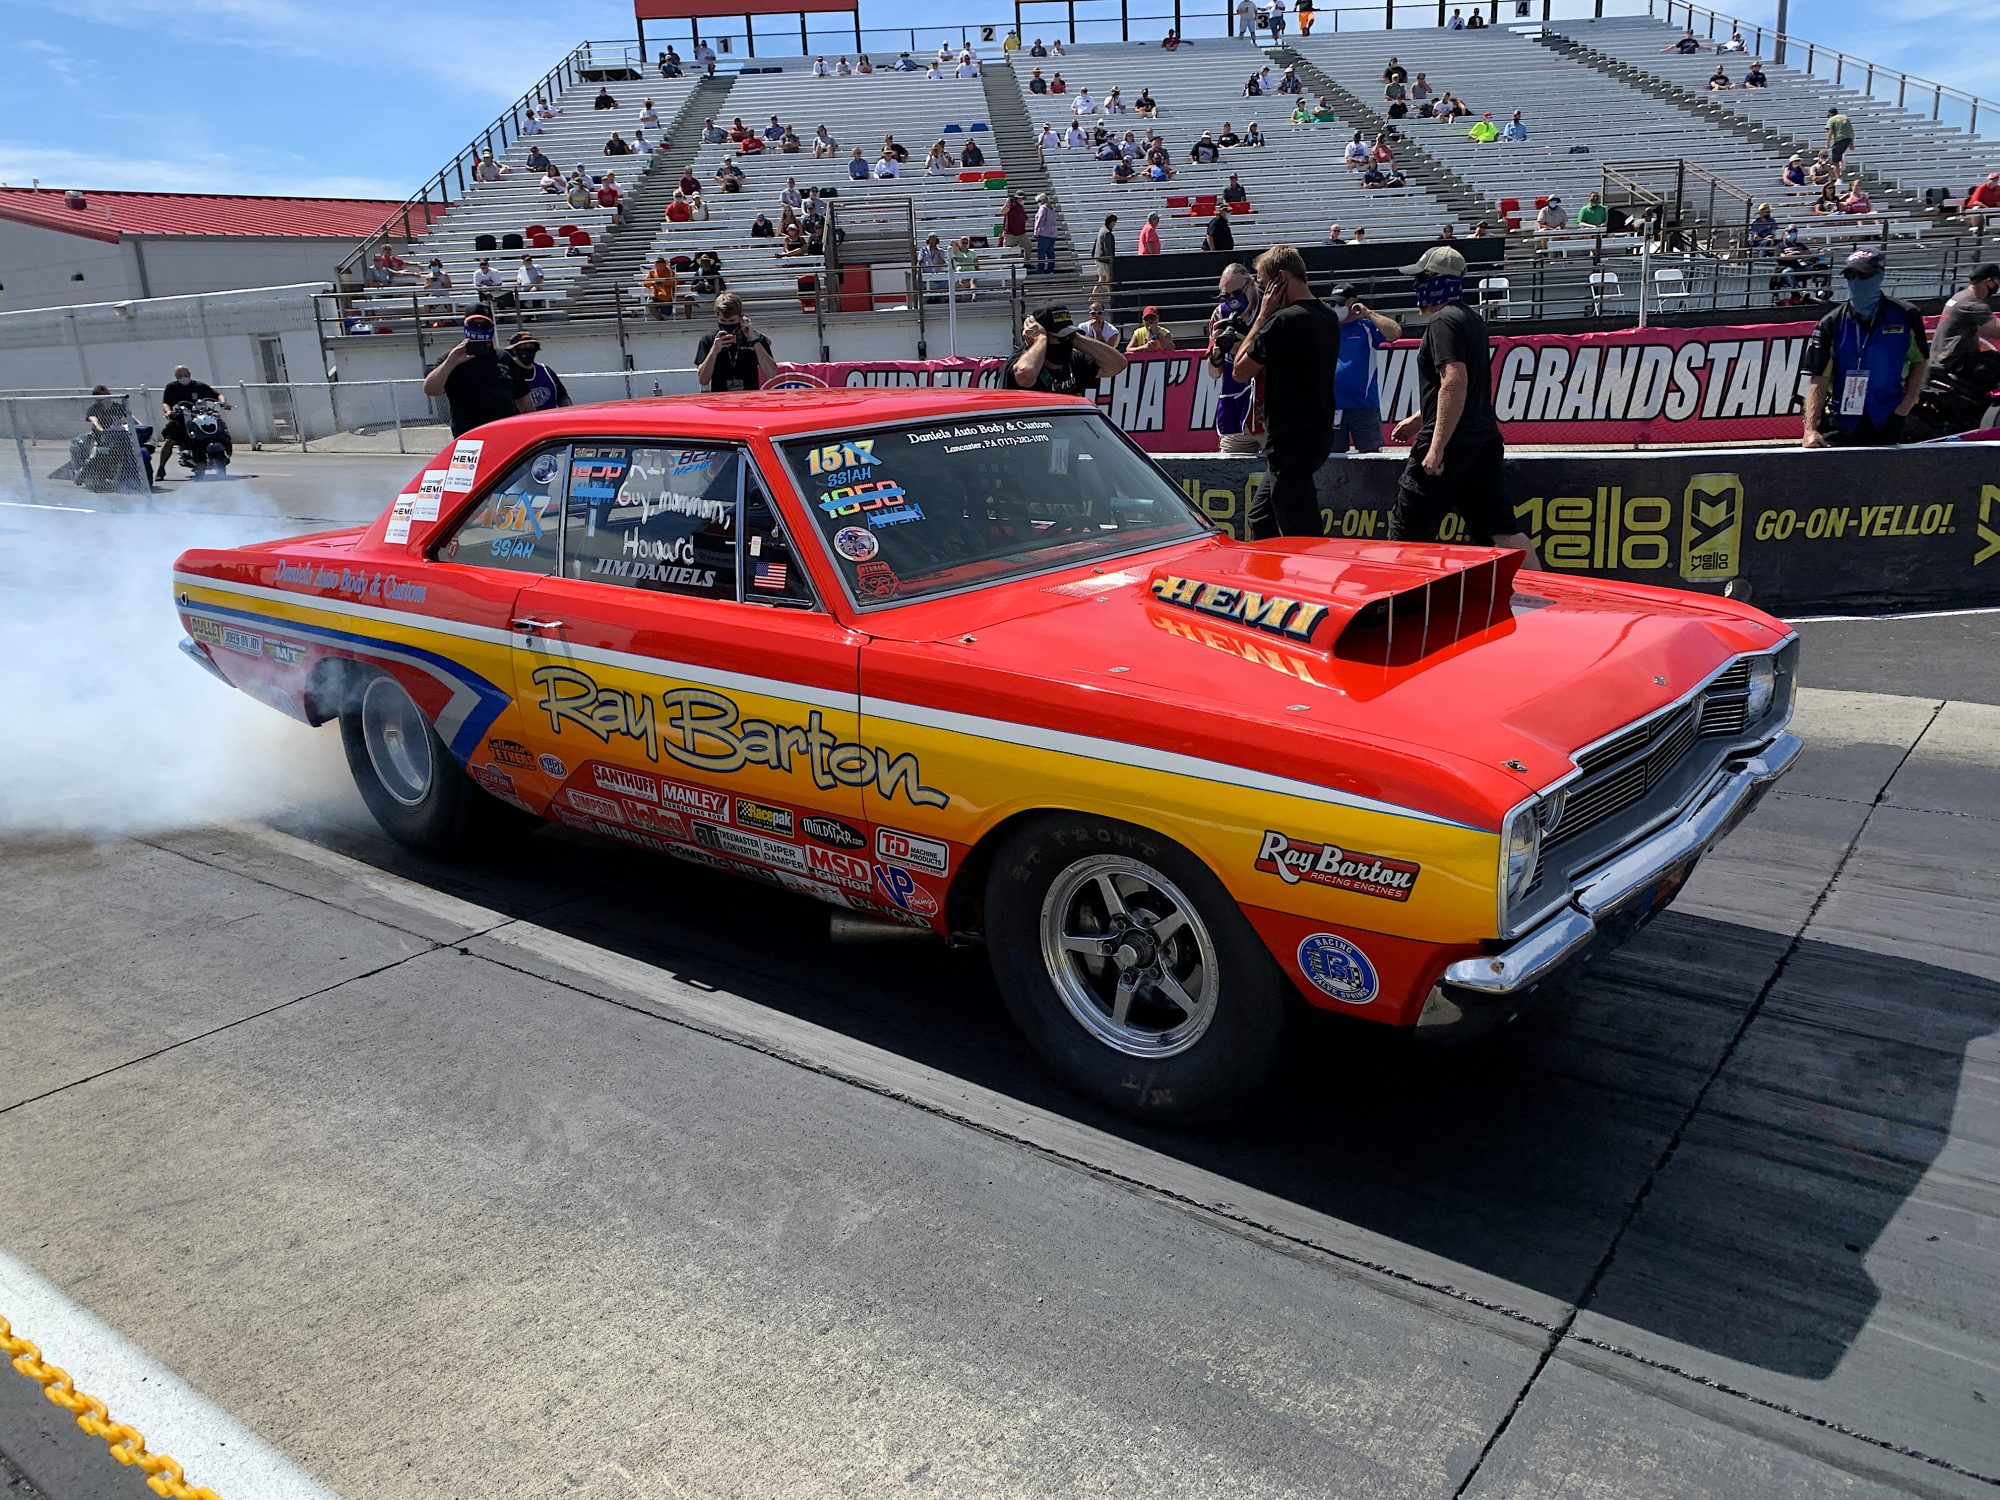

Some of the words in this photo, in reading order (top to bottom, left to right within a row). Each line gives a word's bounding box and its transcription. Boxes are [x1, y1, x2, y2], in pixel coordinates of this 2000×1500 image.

[1517, 2, 1528, 15] 4
[1257, 15, 1269, 29] 3
[720, 38, 729, 53] 1
[982, 27, 994, 42] 2
[907, 431, 951, 444] Daniels
[954, 427, 978, 438] Auto
[978, 423, 1004, 435] Body
[1006, 422, 1017, 432] &
[1016, 420, 1052, 431] Custom
[944, 442, 985, 454] Lancaster,
[985, 439, 997, 448] PA
[1755, 504, 1954, 540] GO-ON-YELLO!
[623, 527, 694, 565] Howard
[275, 559, 312, 585] Daniels
[315, 567, 338, 589] Auto
[340, 568, 367, 599] Body
[370, 573, 380, 596] &
[384, 574, 427, 603] Custom
[591, 558, 631, 577] JIM
[632, 564, 716, 587] DANIELS
[1152, 575, 1329, 643] HEMI
[192, 618, 221, 637] BULLET
[276, 646, 298, 662] M/T
[532, 665, 658, 763] Ray
[662, 687, 951, 810] Barton
[542, 757, 564, 775] NHRA
[593, 765, 655, 793] SANTHUFF
[572, 794, 618, 819] SIMPSON
[663, 783, 719, 811] MANLEY
[664, 801, 704, 817] CONNECTING
[749, 803, 792, 828] Racepak
[719, 829, 760, 848] TREEMASTER
[723, 841, 760, 858] CONVERTER
[763, 842, 796, 858] SUPER
[664, 842, 729, 868] COMETIC
[763, 852, 805, 871] DAMPER
[809, 848, 869, 882] MSD
[910, 847, 938, 859] MACHINE
[910, 853, 942, 867] PRODUCTS
[1259, 832, 1315, 883] Ray
[1315, 845, 1412, 888] Barton
[814, 869, 872, 894] IGNITION
[873, 864, 915, 910] VP
[1310, 872, 1351, 887] RACING
[1353, 882, 1403, 898] ENGINES
[1315, 938, 1353, 954] RACING
[1312, 975, 1338, 995] VALVE
[1340, 986, 1370, 1000] SPRINGS
